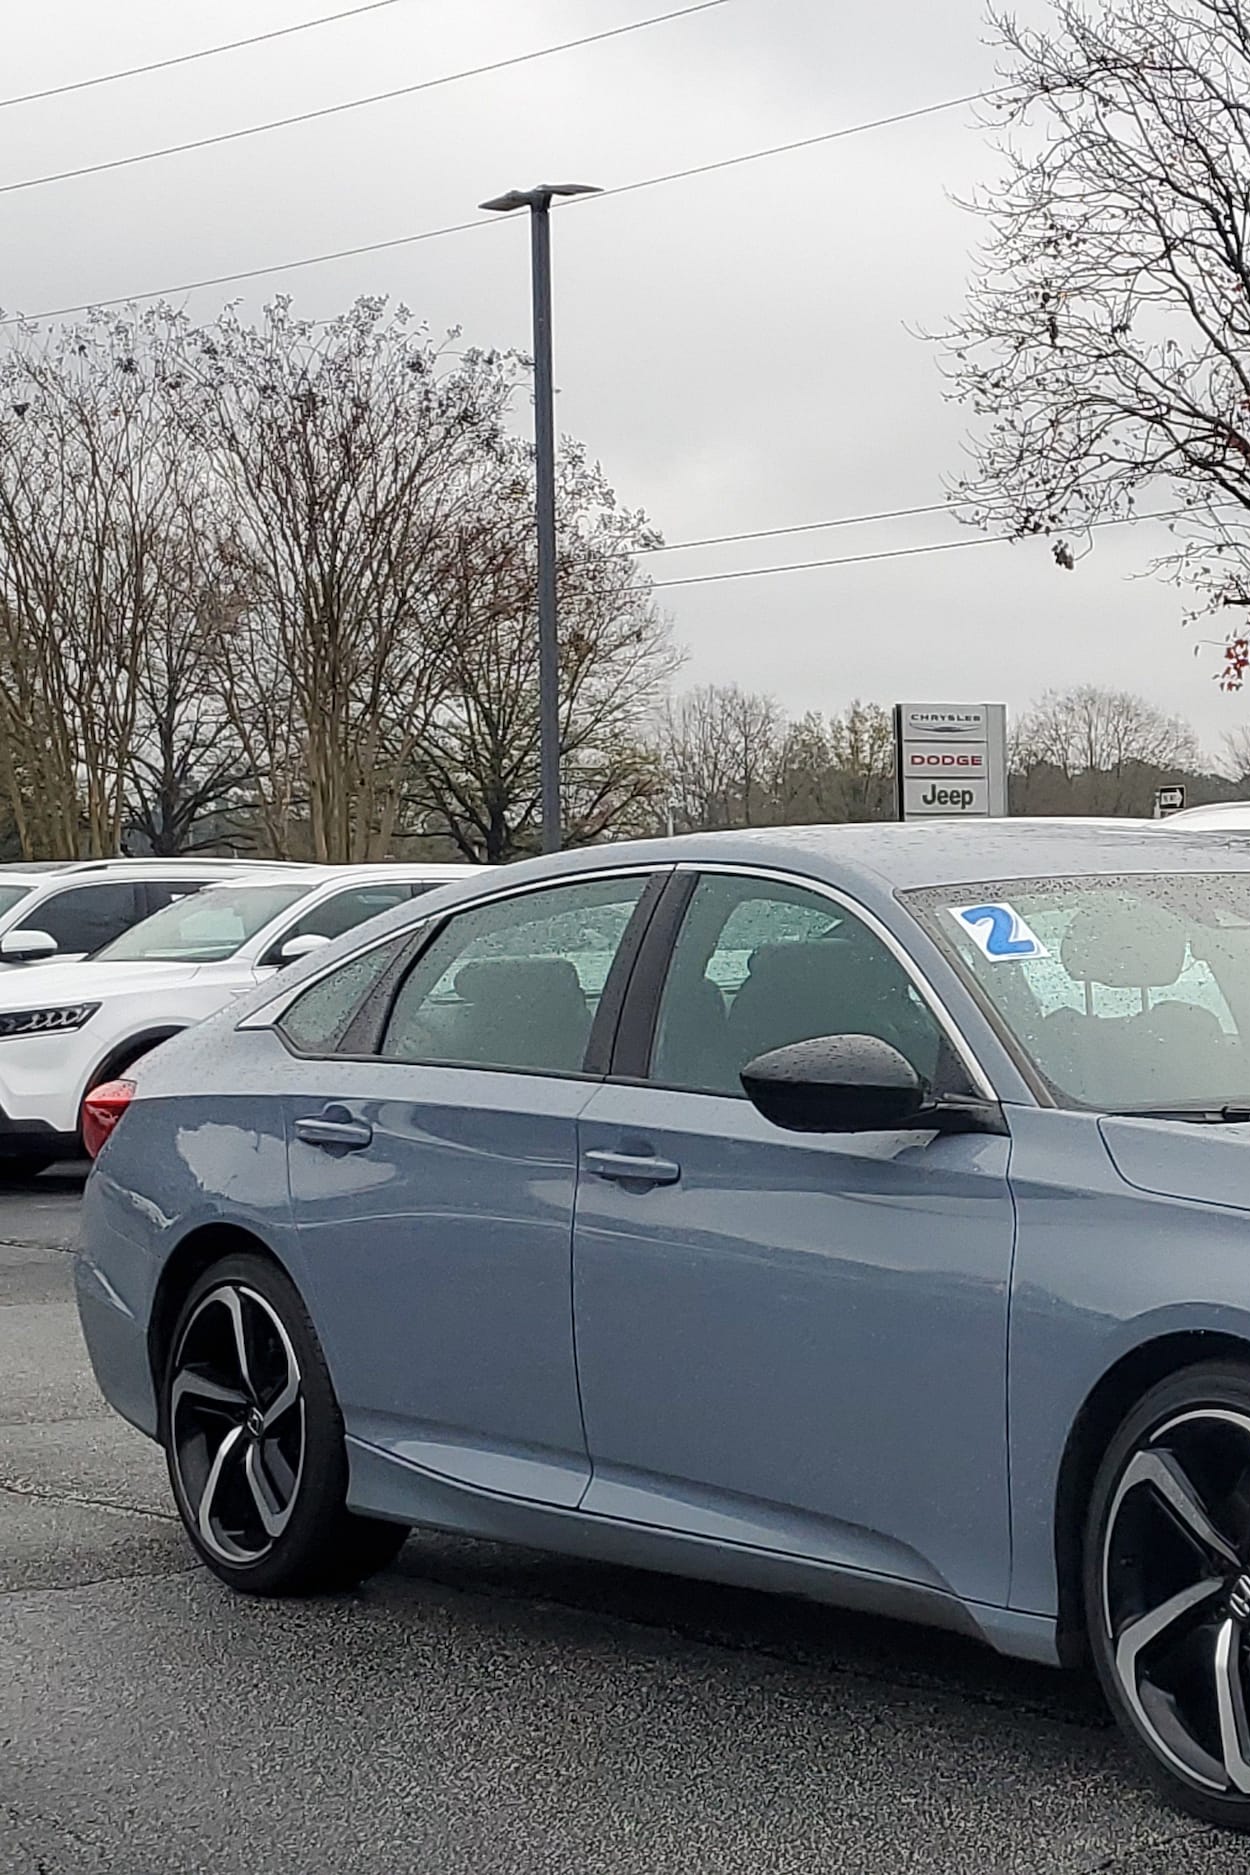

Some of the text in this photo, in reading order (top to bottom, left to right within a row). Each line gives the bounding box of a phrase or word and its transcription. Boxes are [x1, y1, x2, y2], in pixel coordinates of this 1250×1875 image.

[910, 713, 981, 722] CHRYSLER
[910, 755, 983, 766] DODGE
[921, 783, 974, 810] Jeep
[961, 906, 1035, 955] 2
